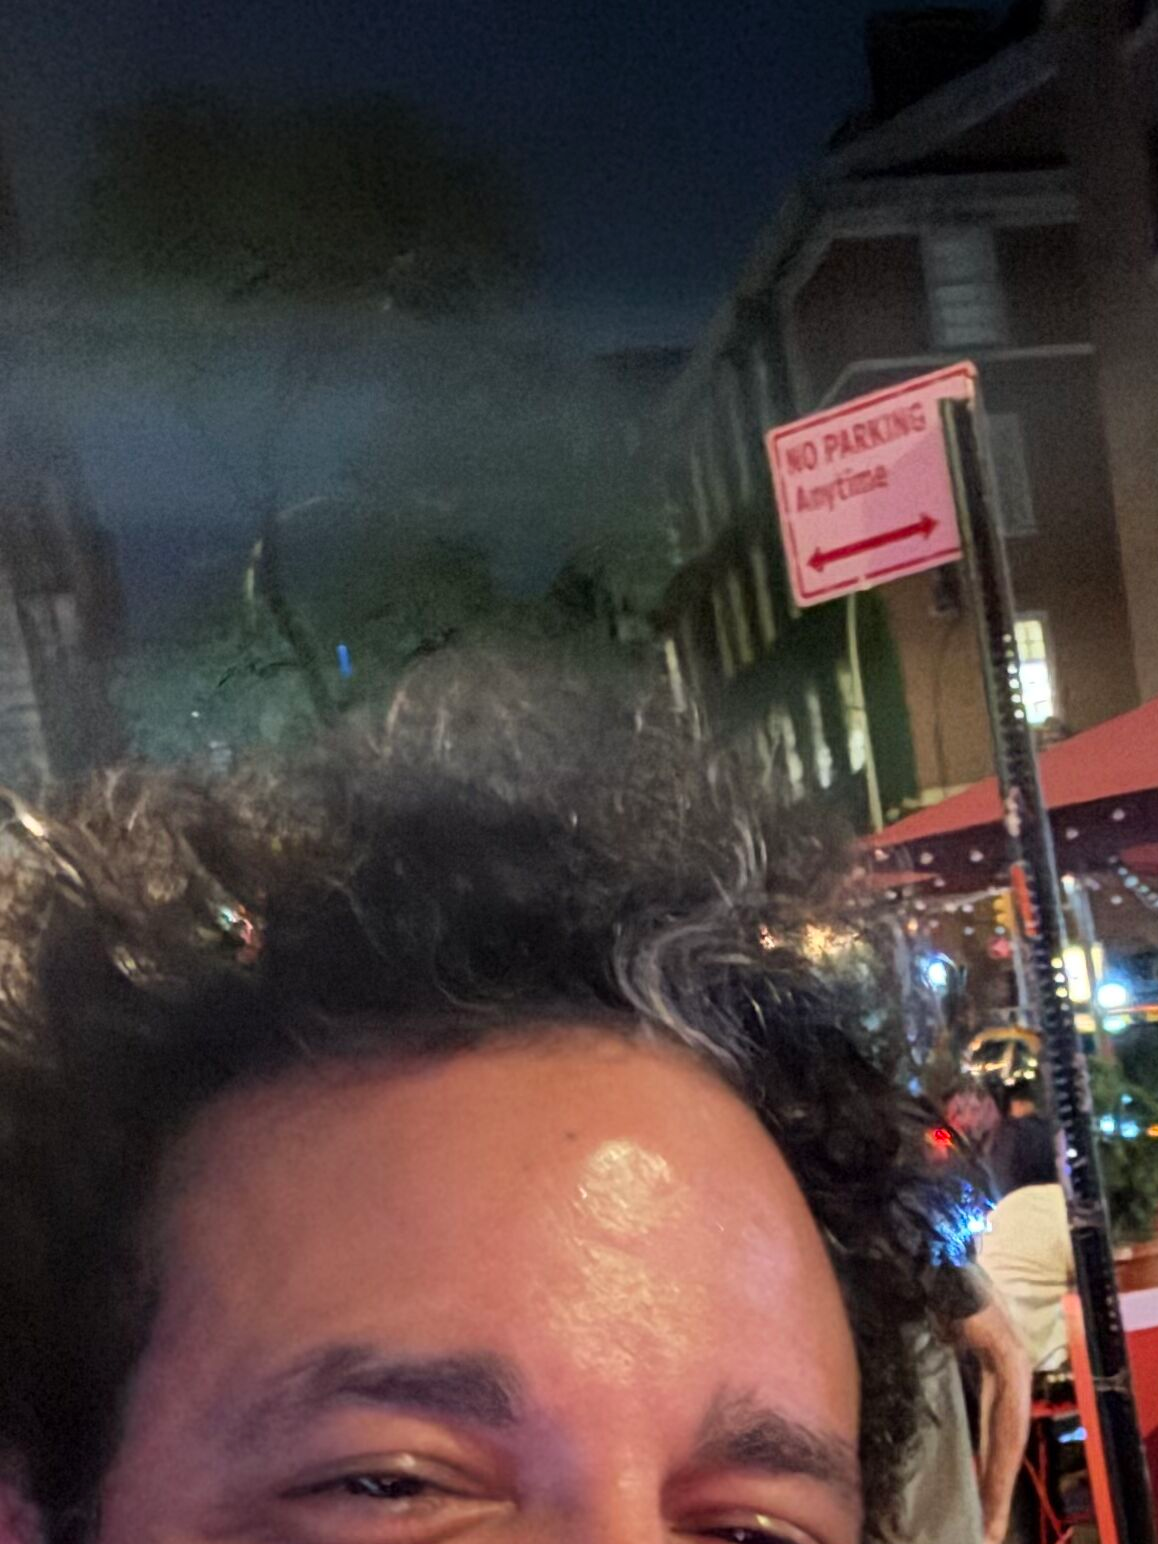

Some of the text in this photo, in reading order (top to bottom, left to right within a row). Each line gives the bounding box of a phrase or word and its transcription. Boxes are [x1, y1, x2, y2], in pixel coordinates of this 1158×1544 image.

[785, 402, 927, 475] NO PARKING
[796, 465, 889, 512] Anytime
